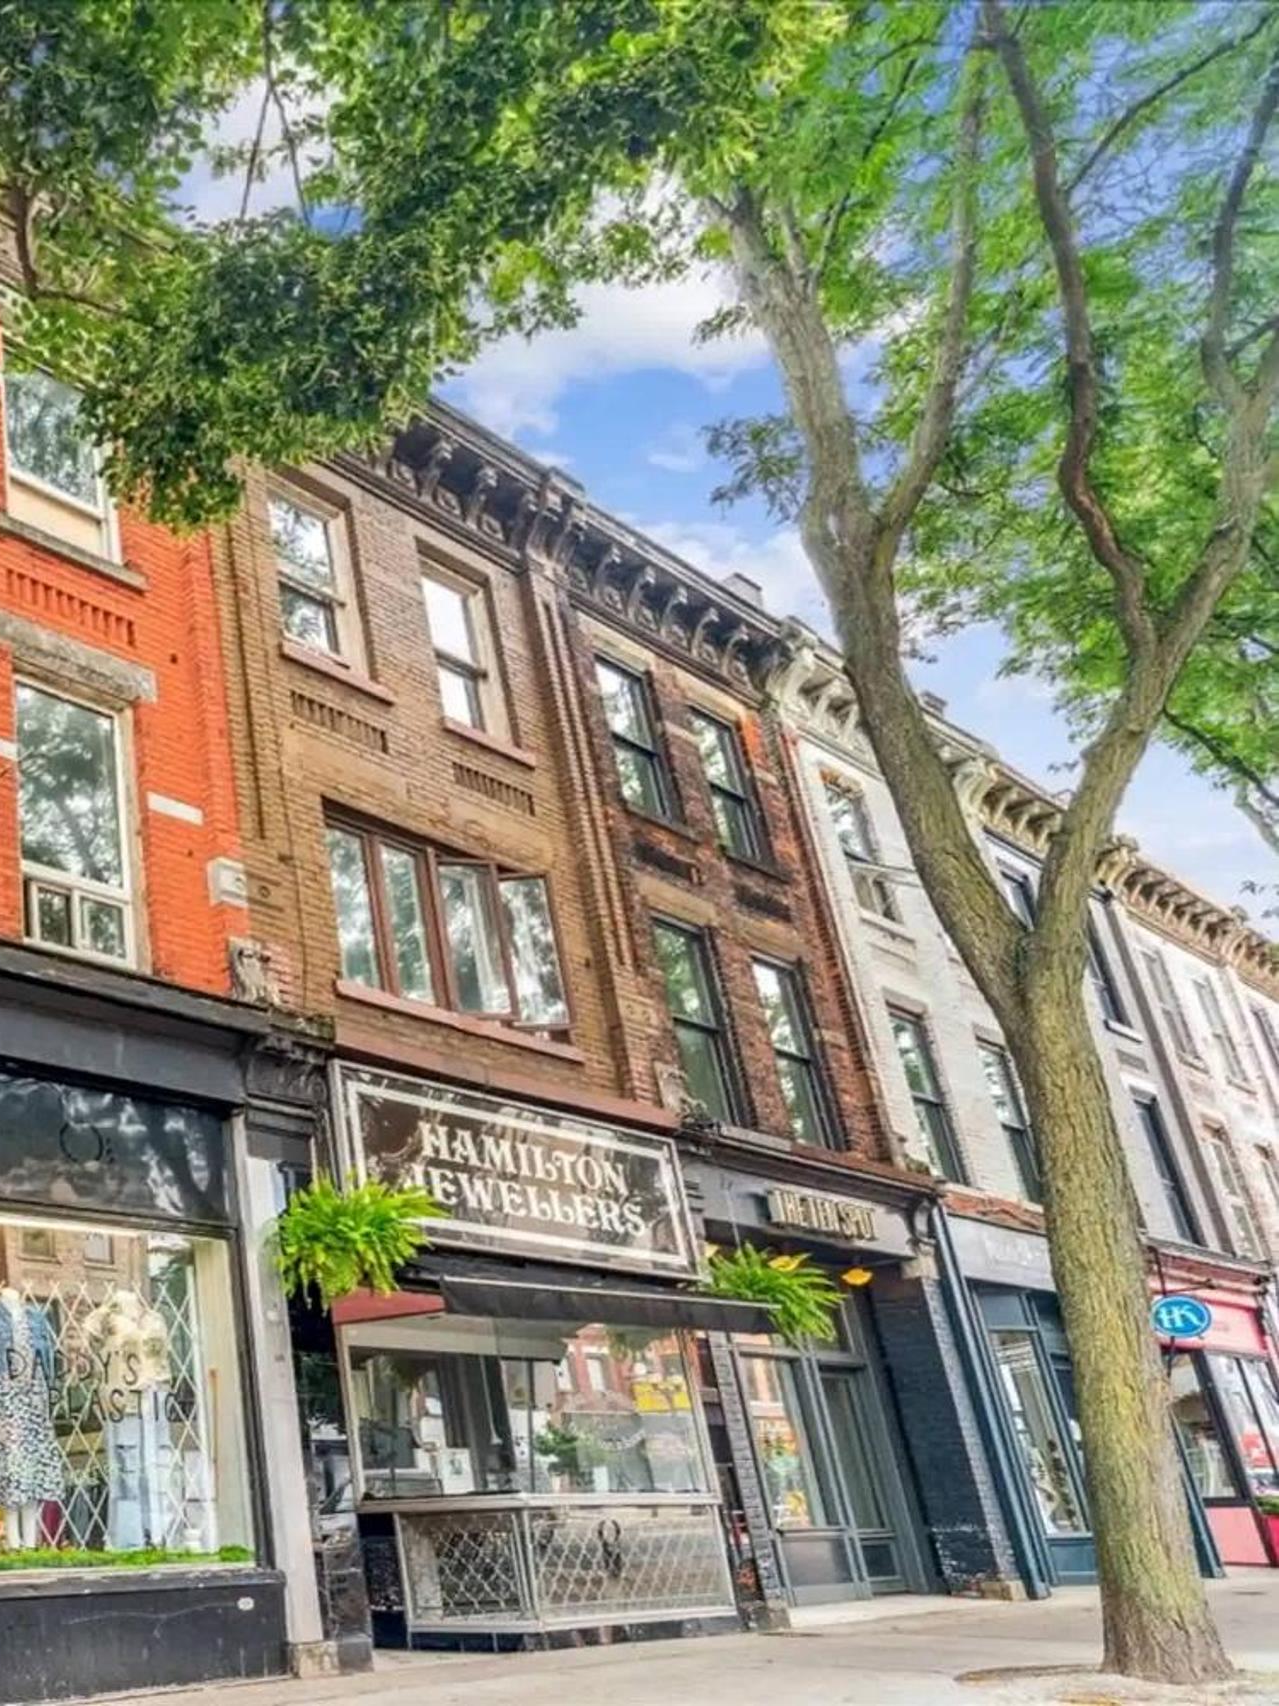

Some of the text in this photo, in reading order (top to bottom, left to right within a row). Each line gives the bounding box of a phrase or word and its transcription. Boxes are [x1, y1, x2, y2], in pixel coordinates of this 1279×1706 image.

[417, 1120, 630, 1197] HAMILTON
[403, 1162, 647, 1237] JEWELLERS
[5, 1348, 141, 1387] DADDY'S
